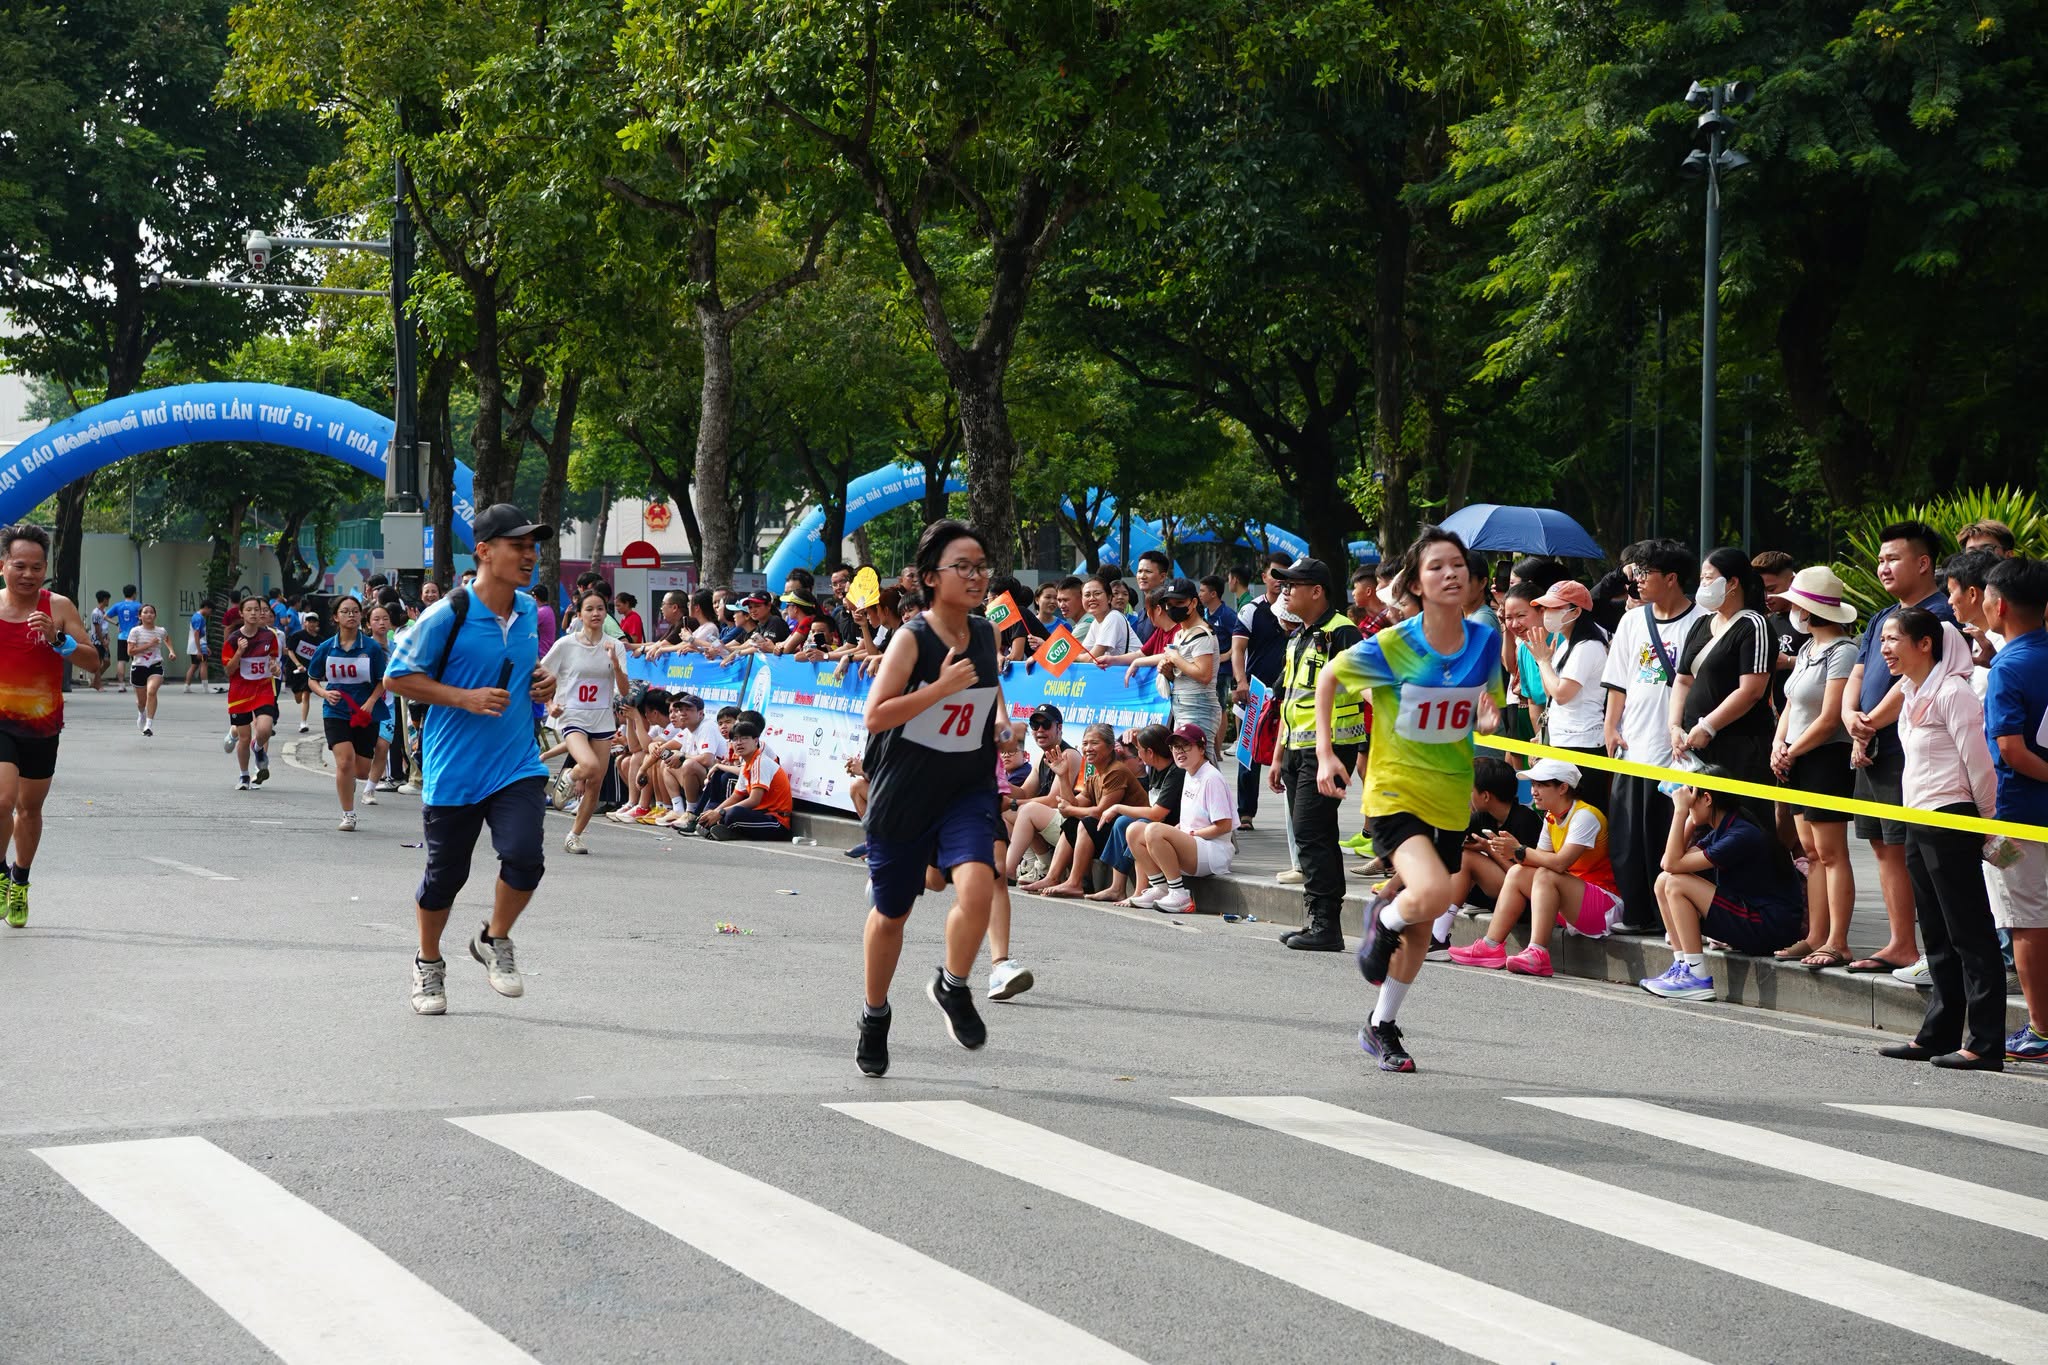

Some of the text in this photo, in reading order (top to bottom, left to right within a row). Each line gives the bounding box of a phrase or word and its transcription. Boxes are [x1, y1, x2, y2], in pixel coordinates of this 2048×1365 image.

[21, 444, 55, 473] BÁO
[52, 409, 139, 457] Hànộimới
[141, 400, 168, 427] MỞ
[172, 400, 217, 424] RỘNG
[221, 397, 253, 420] LẦN
[259, 404, 293, 425] THỨ
[293, 412, 313, 431] 51
[328, 422, 345, 442] VÌ
[346, 429, 379, 457] HÒA
[882, 481, 903, 497] CHẠY
[904, 476, 920, 488] BÁO
[300, 645, 315, 657] 220
[1048, 641, 1068, 661] Cozy
[250, 662, 266, 675] 55
[329, 663, 358, 678] 110
[578, 685, 598, 702] 02
[1043, 676, 1087, 698] CHUNG KẾT
[938, 703, 975, 737] 78
[1417, 700, 1472, 731] 116
